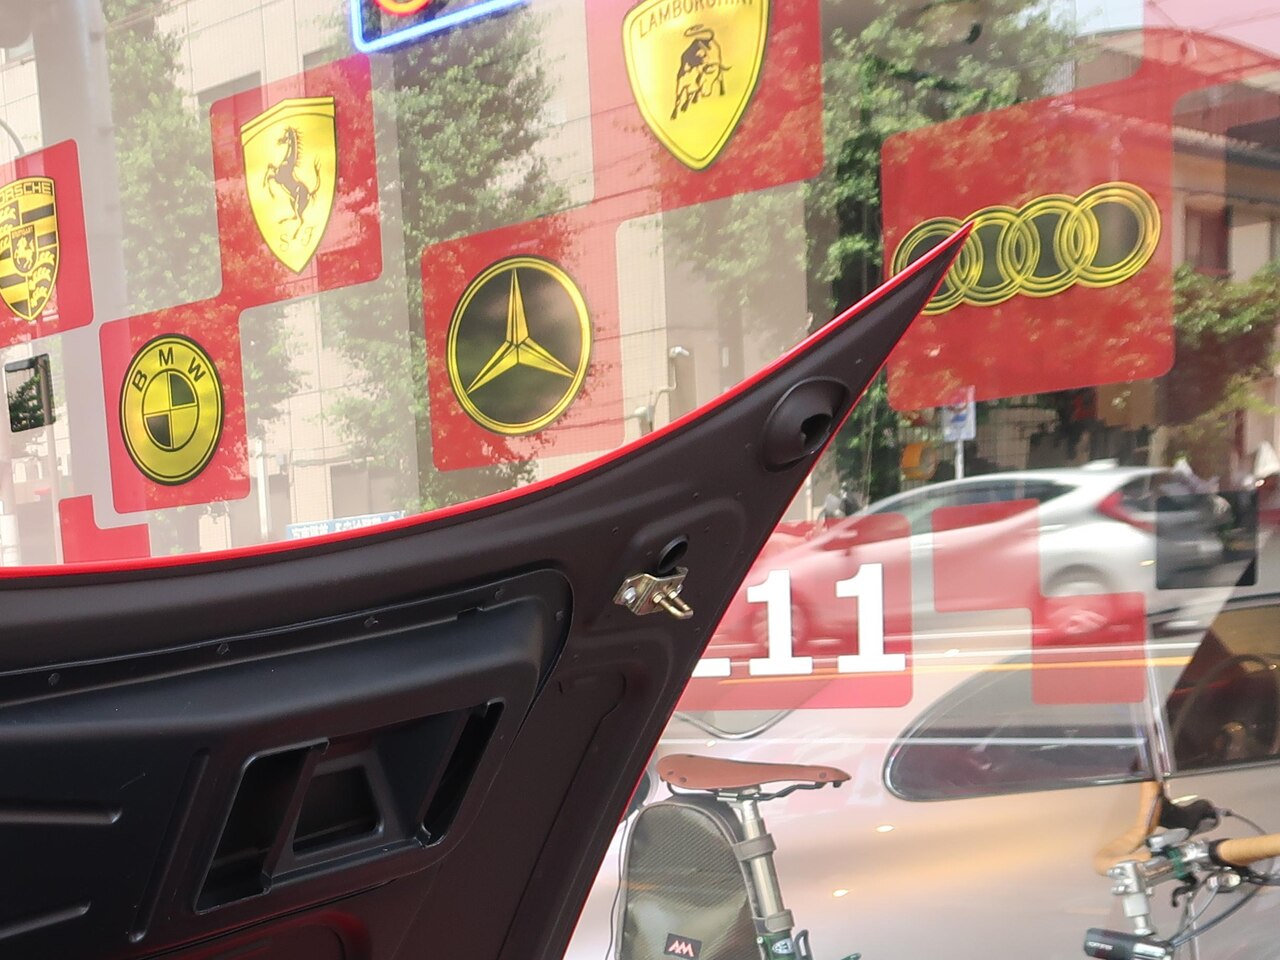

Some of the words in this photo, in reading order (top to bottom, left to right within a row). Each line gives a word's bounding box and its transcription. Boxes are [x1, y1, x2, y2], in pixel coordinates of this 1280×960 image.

[639, 0, 753, 38] LAMBOR
[132, 346, 207, 392] BMW
[692, 563, 906, 677] 11
